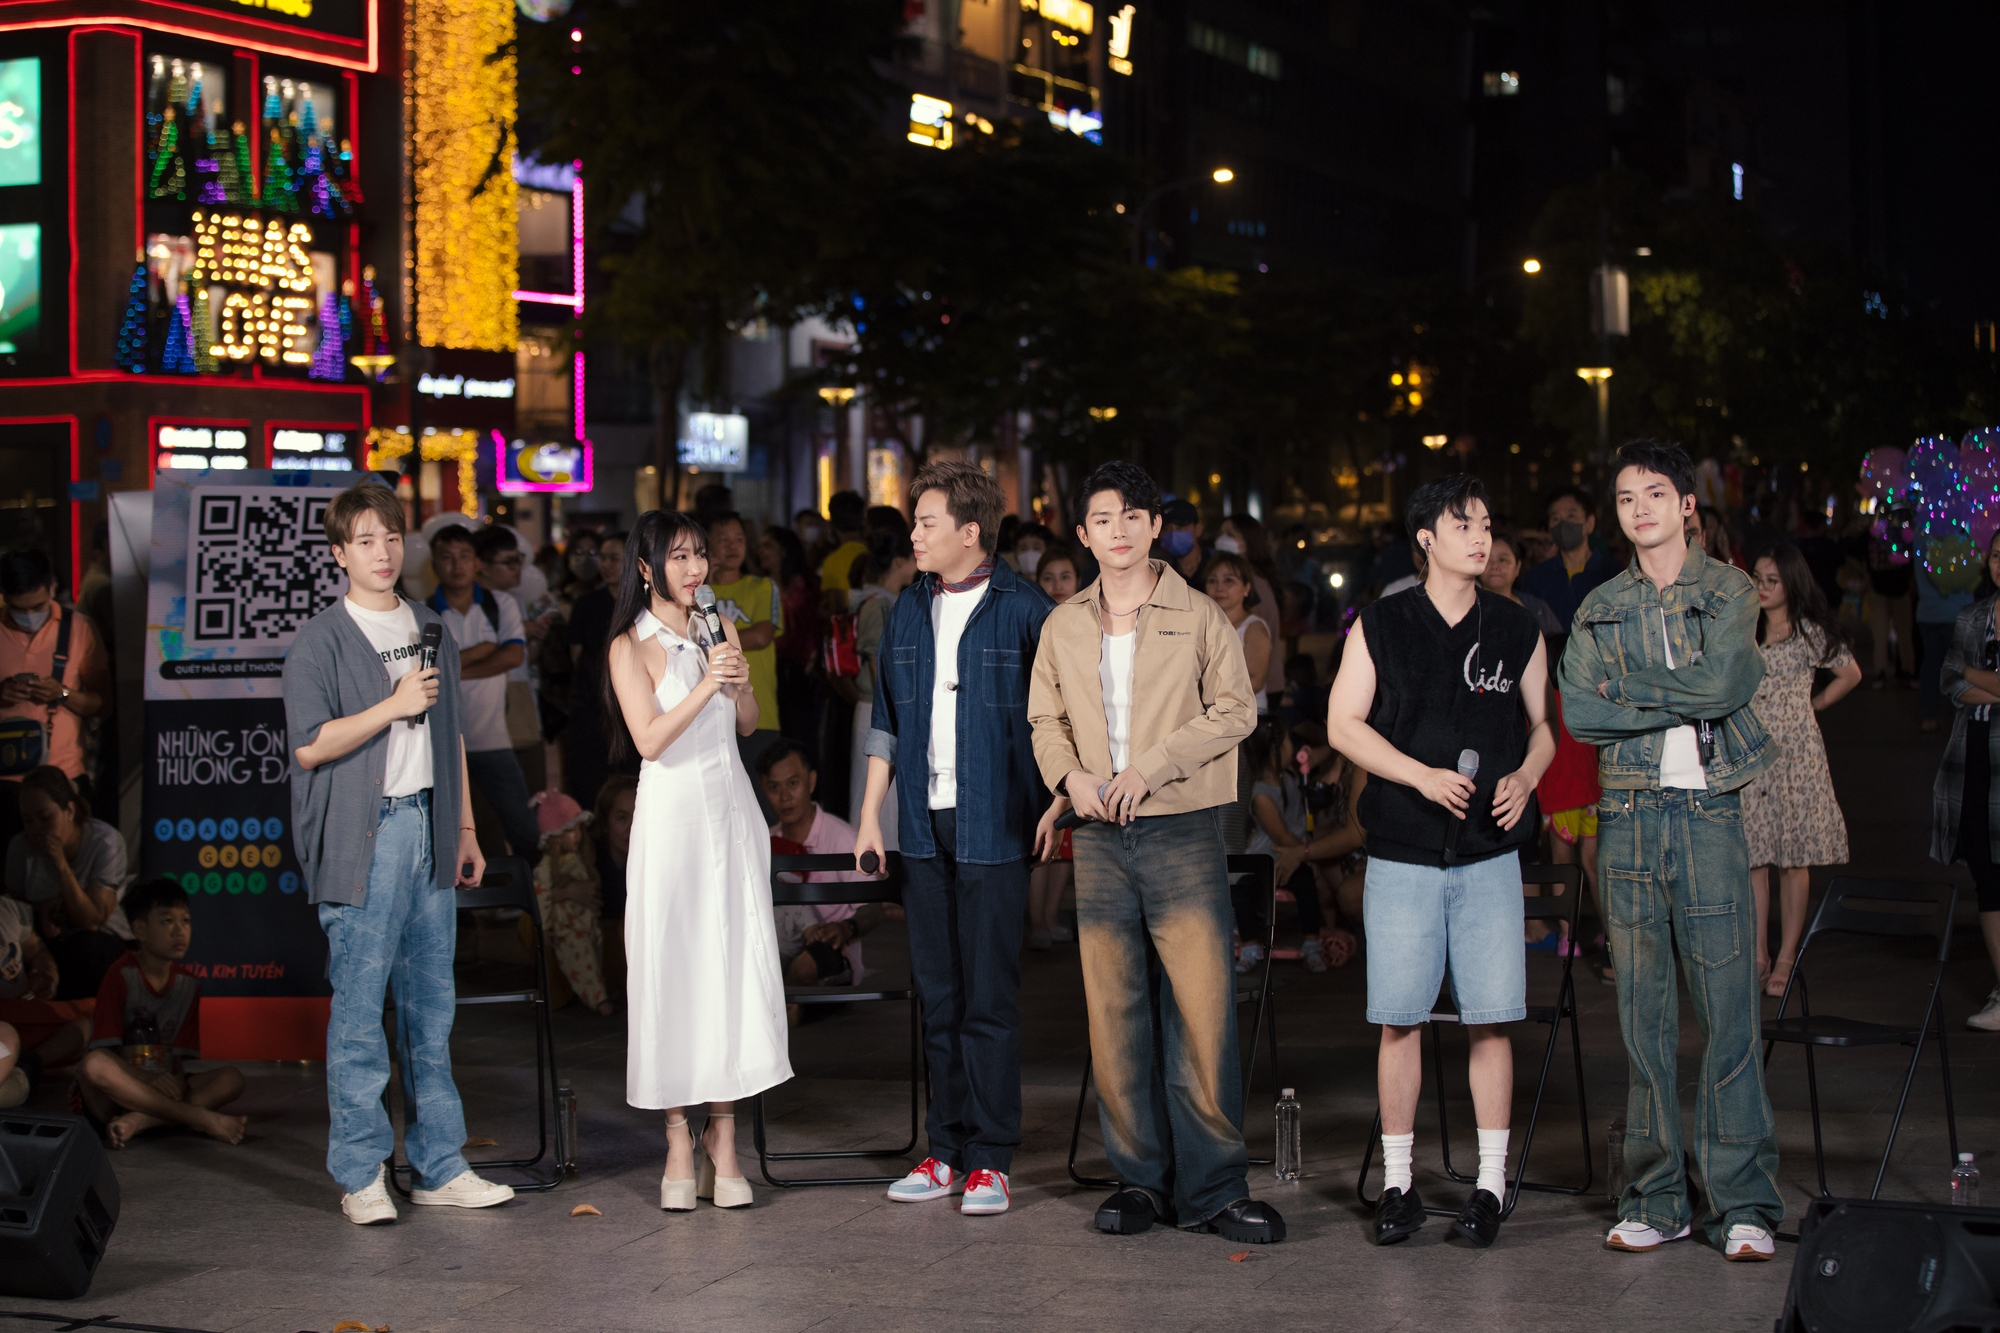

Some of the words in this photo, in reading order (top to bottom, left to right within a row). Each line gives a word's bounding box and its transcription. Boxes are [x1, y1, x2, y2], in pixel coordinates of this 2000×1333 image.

[393, 642, 422, 660] COOP
[218, 664, 233, 675] QR
[248, 660, 285, 673] THƯỞN
[157, 723, 236, 758] NHỮNG
[157, 819, 280, 839] ORANGE
[202, 848, 279, 866] GREY
[211, 963, 237, 979] KIM
